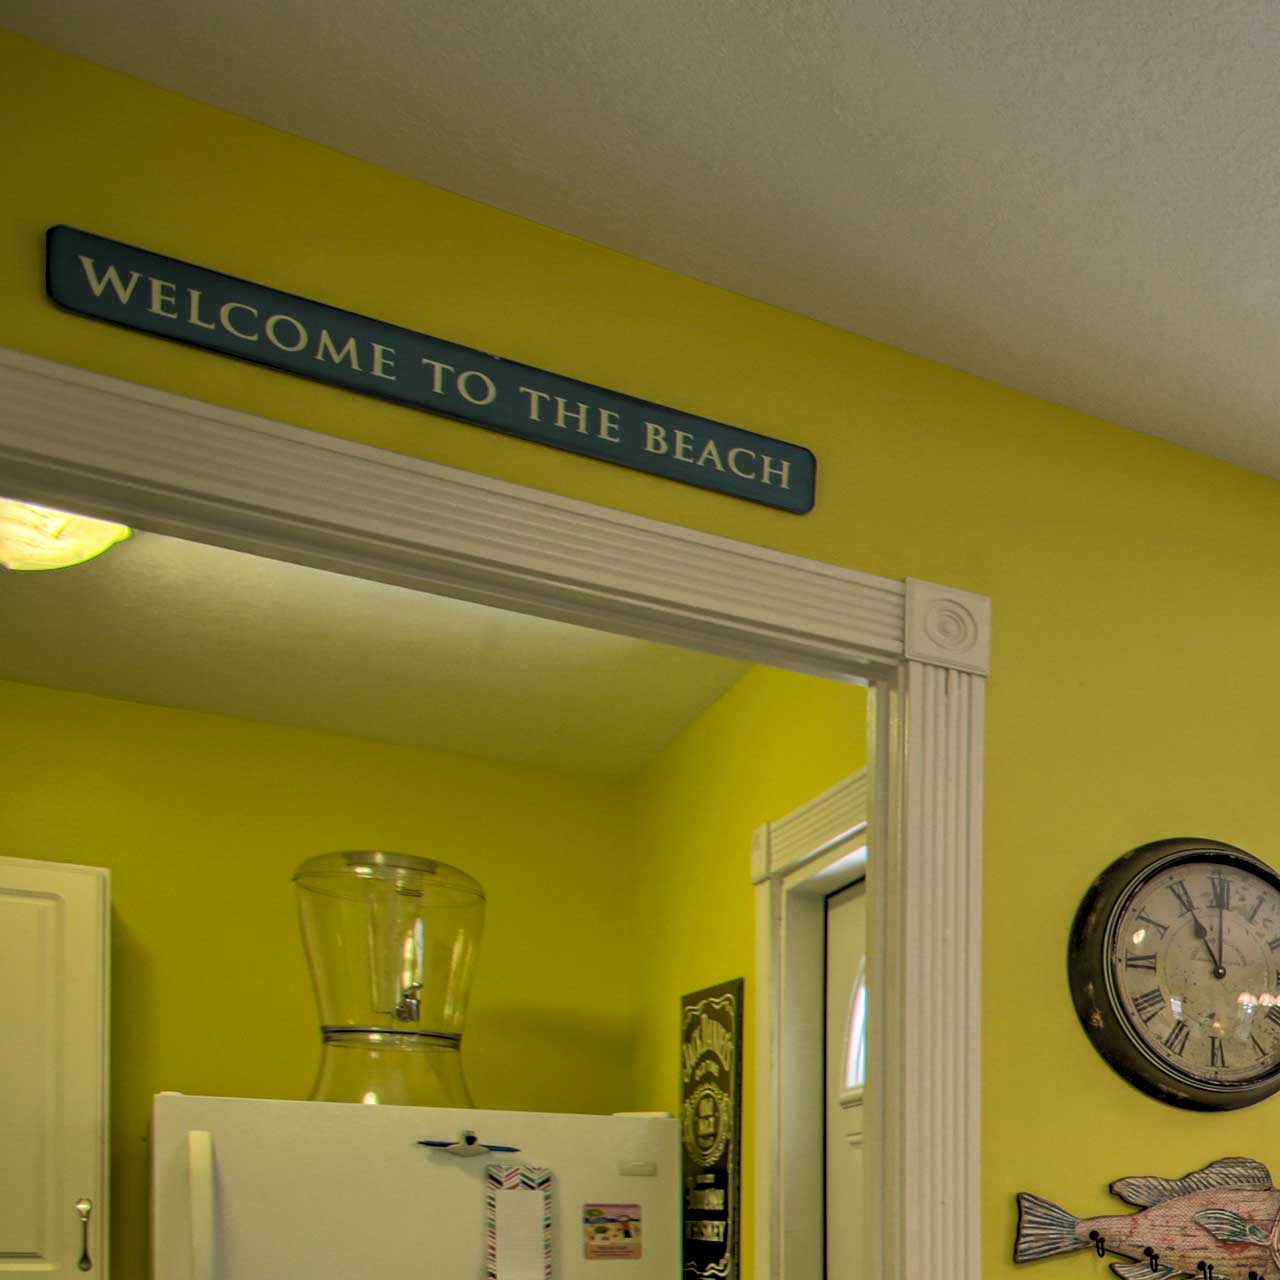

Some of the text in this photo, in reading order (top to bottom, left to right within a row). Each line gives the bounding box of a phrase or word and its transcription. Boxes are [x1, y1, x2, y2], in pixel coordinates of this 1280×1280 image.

[79, 254, 792, 490] WELCOME TO THE BEACH
